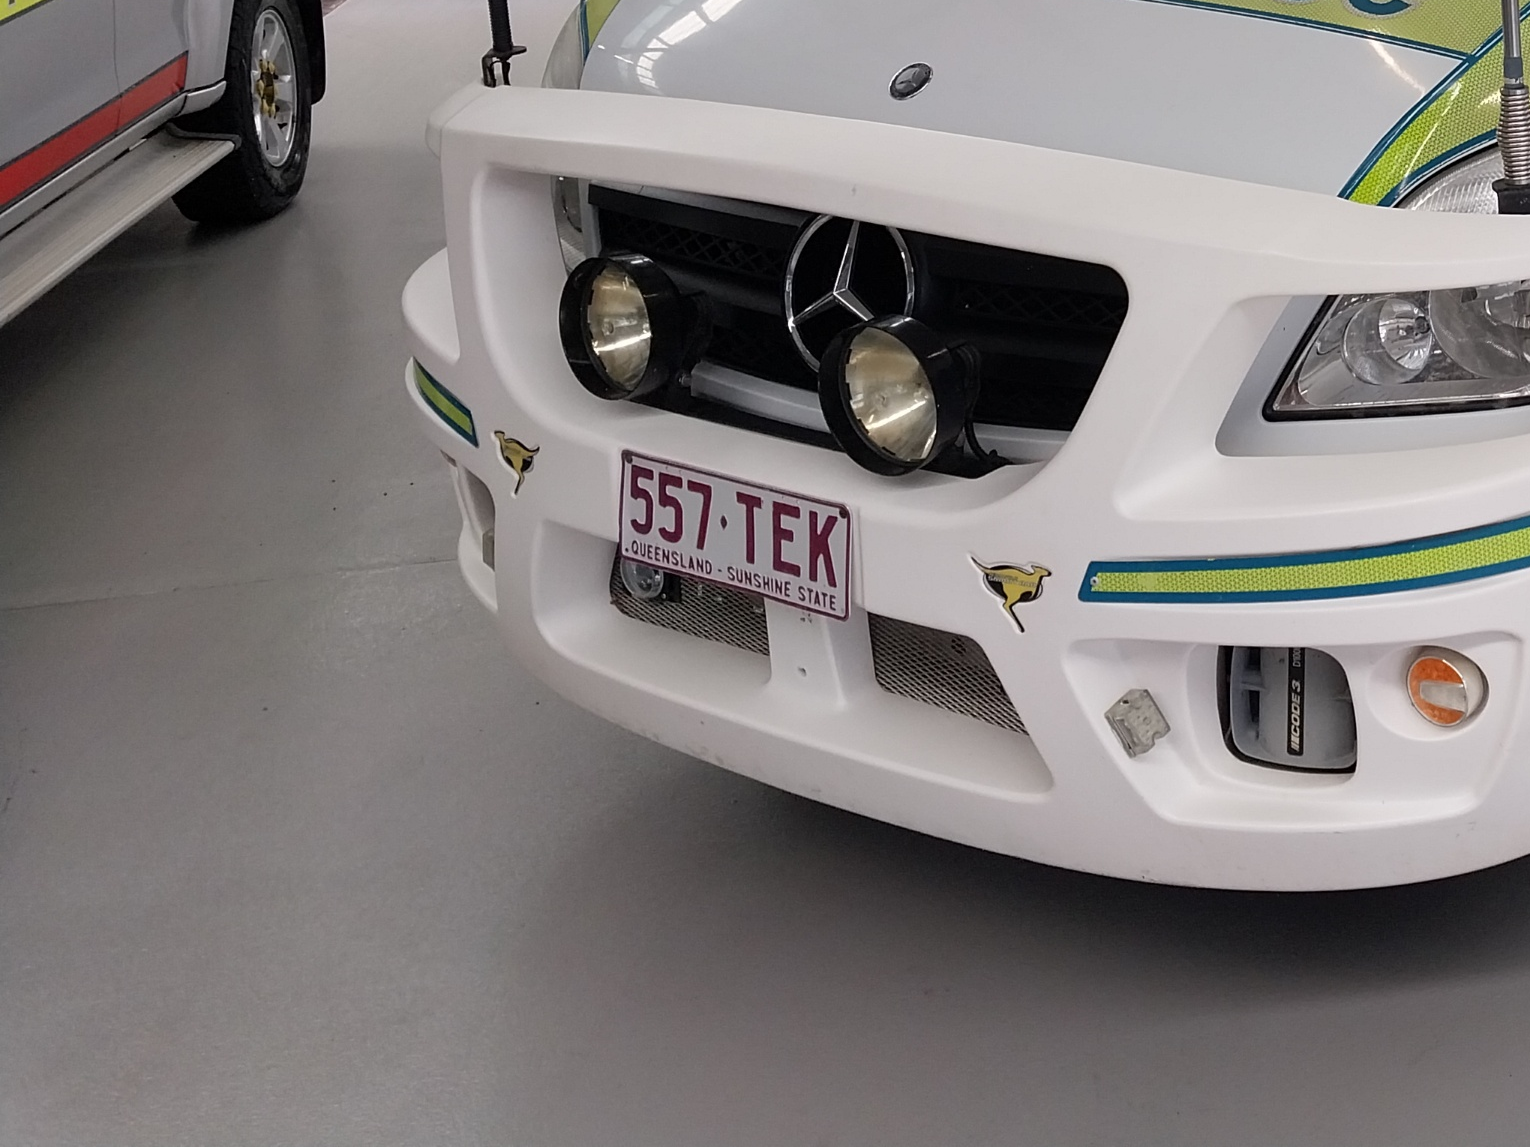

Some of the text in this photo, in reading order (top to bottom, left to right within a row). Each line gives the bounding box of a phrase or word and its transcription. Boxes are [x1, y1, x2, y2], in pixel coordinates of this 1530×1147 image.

[631, 540, 713, 575] QUEENSLAND
[727, 566, 792, 597] SUNSHINE
[798, 585, 837, 611] STATE
[1291, 692, 1301, 738] CODE
